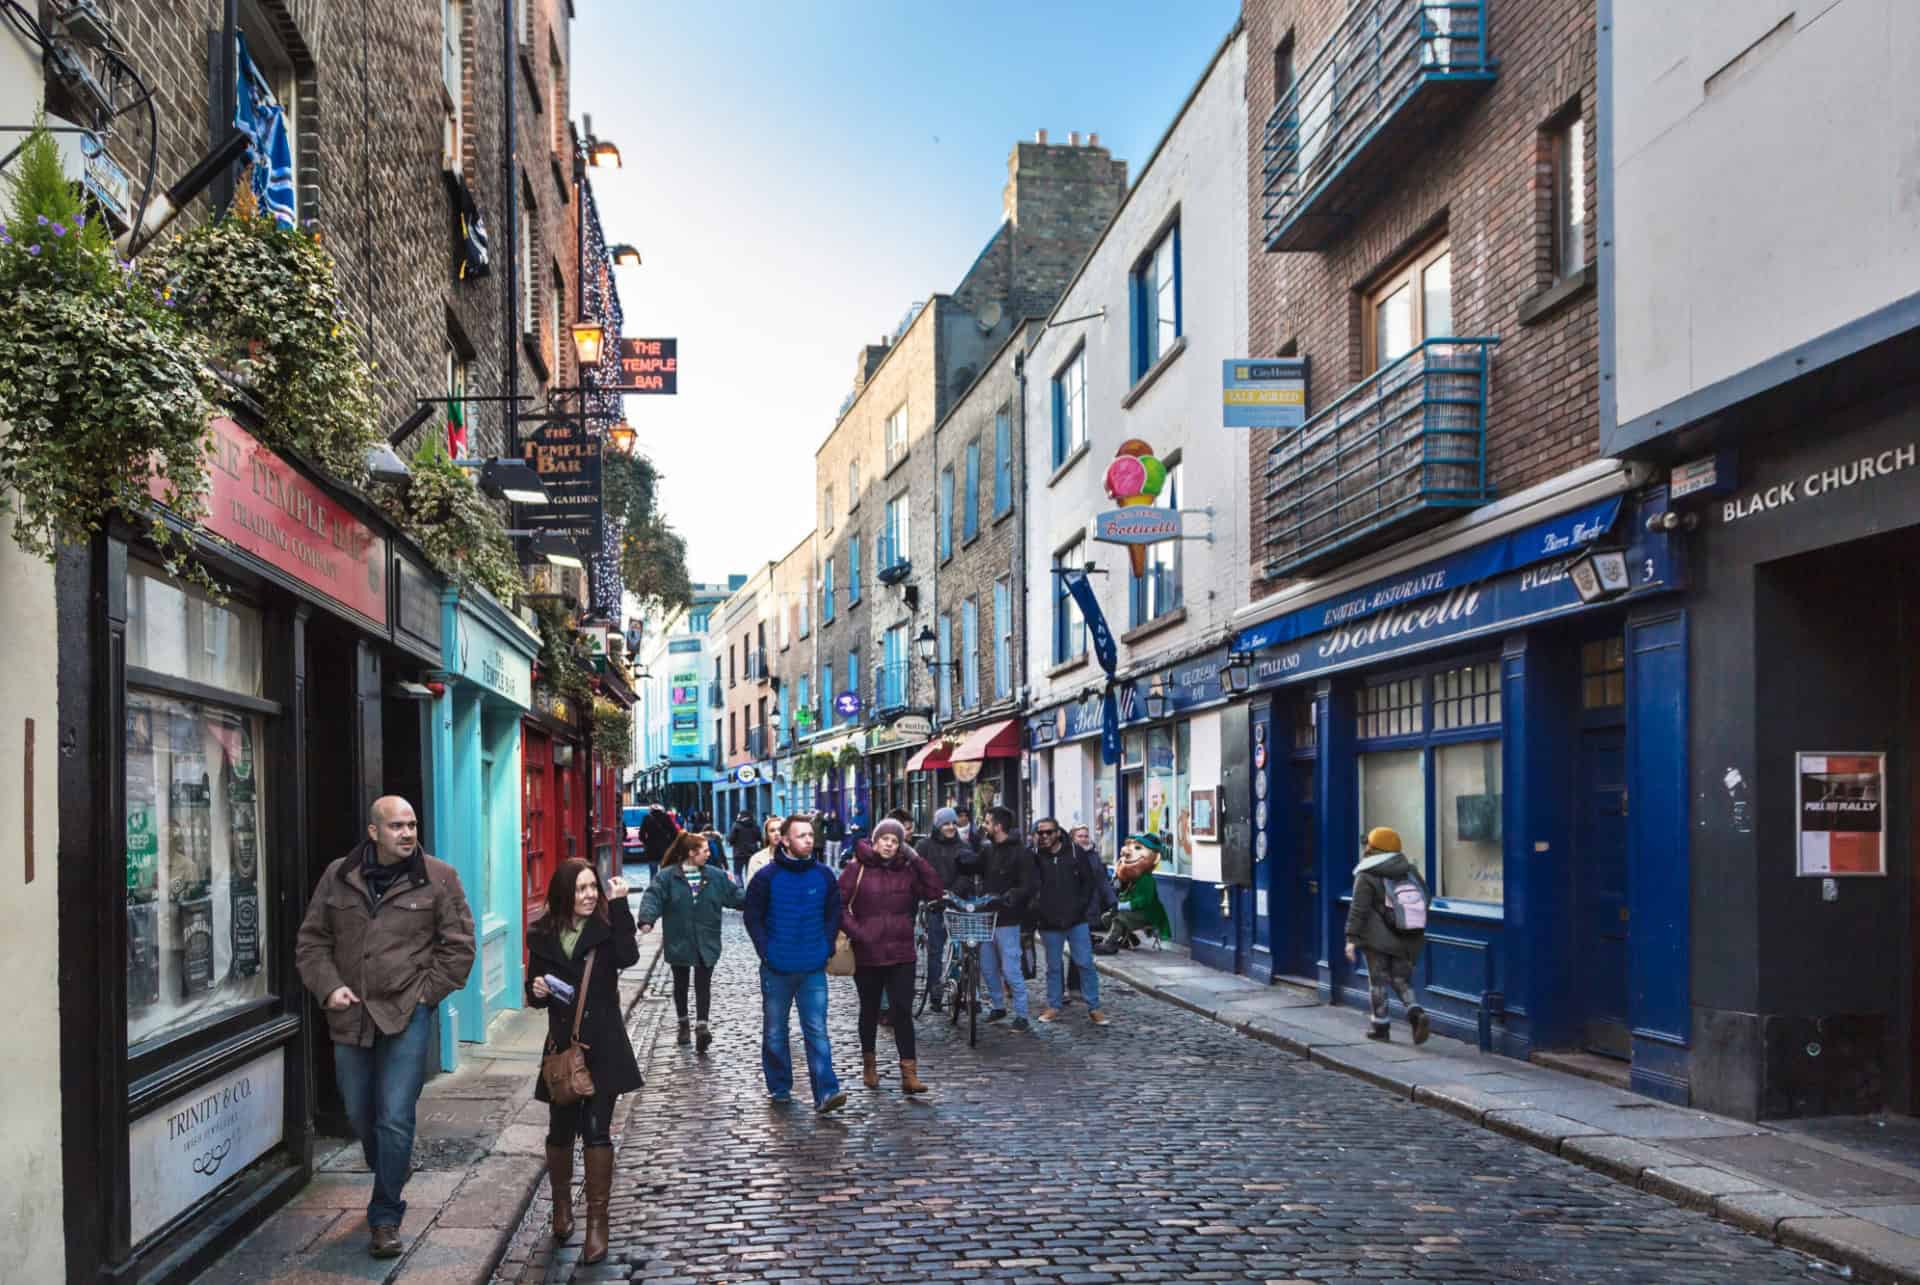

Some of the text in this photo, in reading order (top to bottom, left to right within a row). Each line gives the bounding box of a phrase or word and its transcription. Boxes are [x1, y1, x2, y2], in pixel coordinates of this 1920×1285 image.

[632, 341, 662, 355] THE
[622, 358, 676, 372] TEMPLE
[634, 376, 663, 389] BAR
[544, 428, 572, 438] THE
[522, 441, 598, 458] TEMPLE
[538, 457, 582, 473] BAR
[1723, 443, 1916, 523] BLACK CHURCH
[248, 454, 327, 539] TEMPLE
[231, 499, 288, 550] TRADING
[1642, 559, 1654, 582] 3
[167, 1091, 222, 1140] TRINITY
[222, 1087, 232, 1109] &
